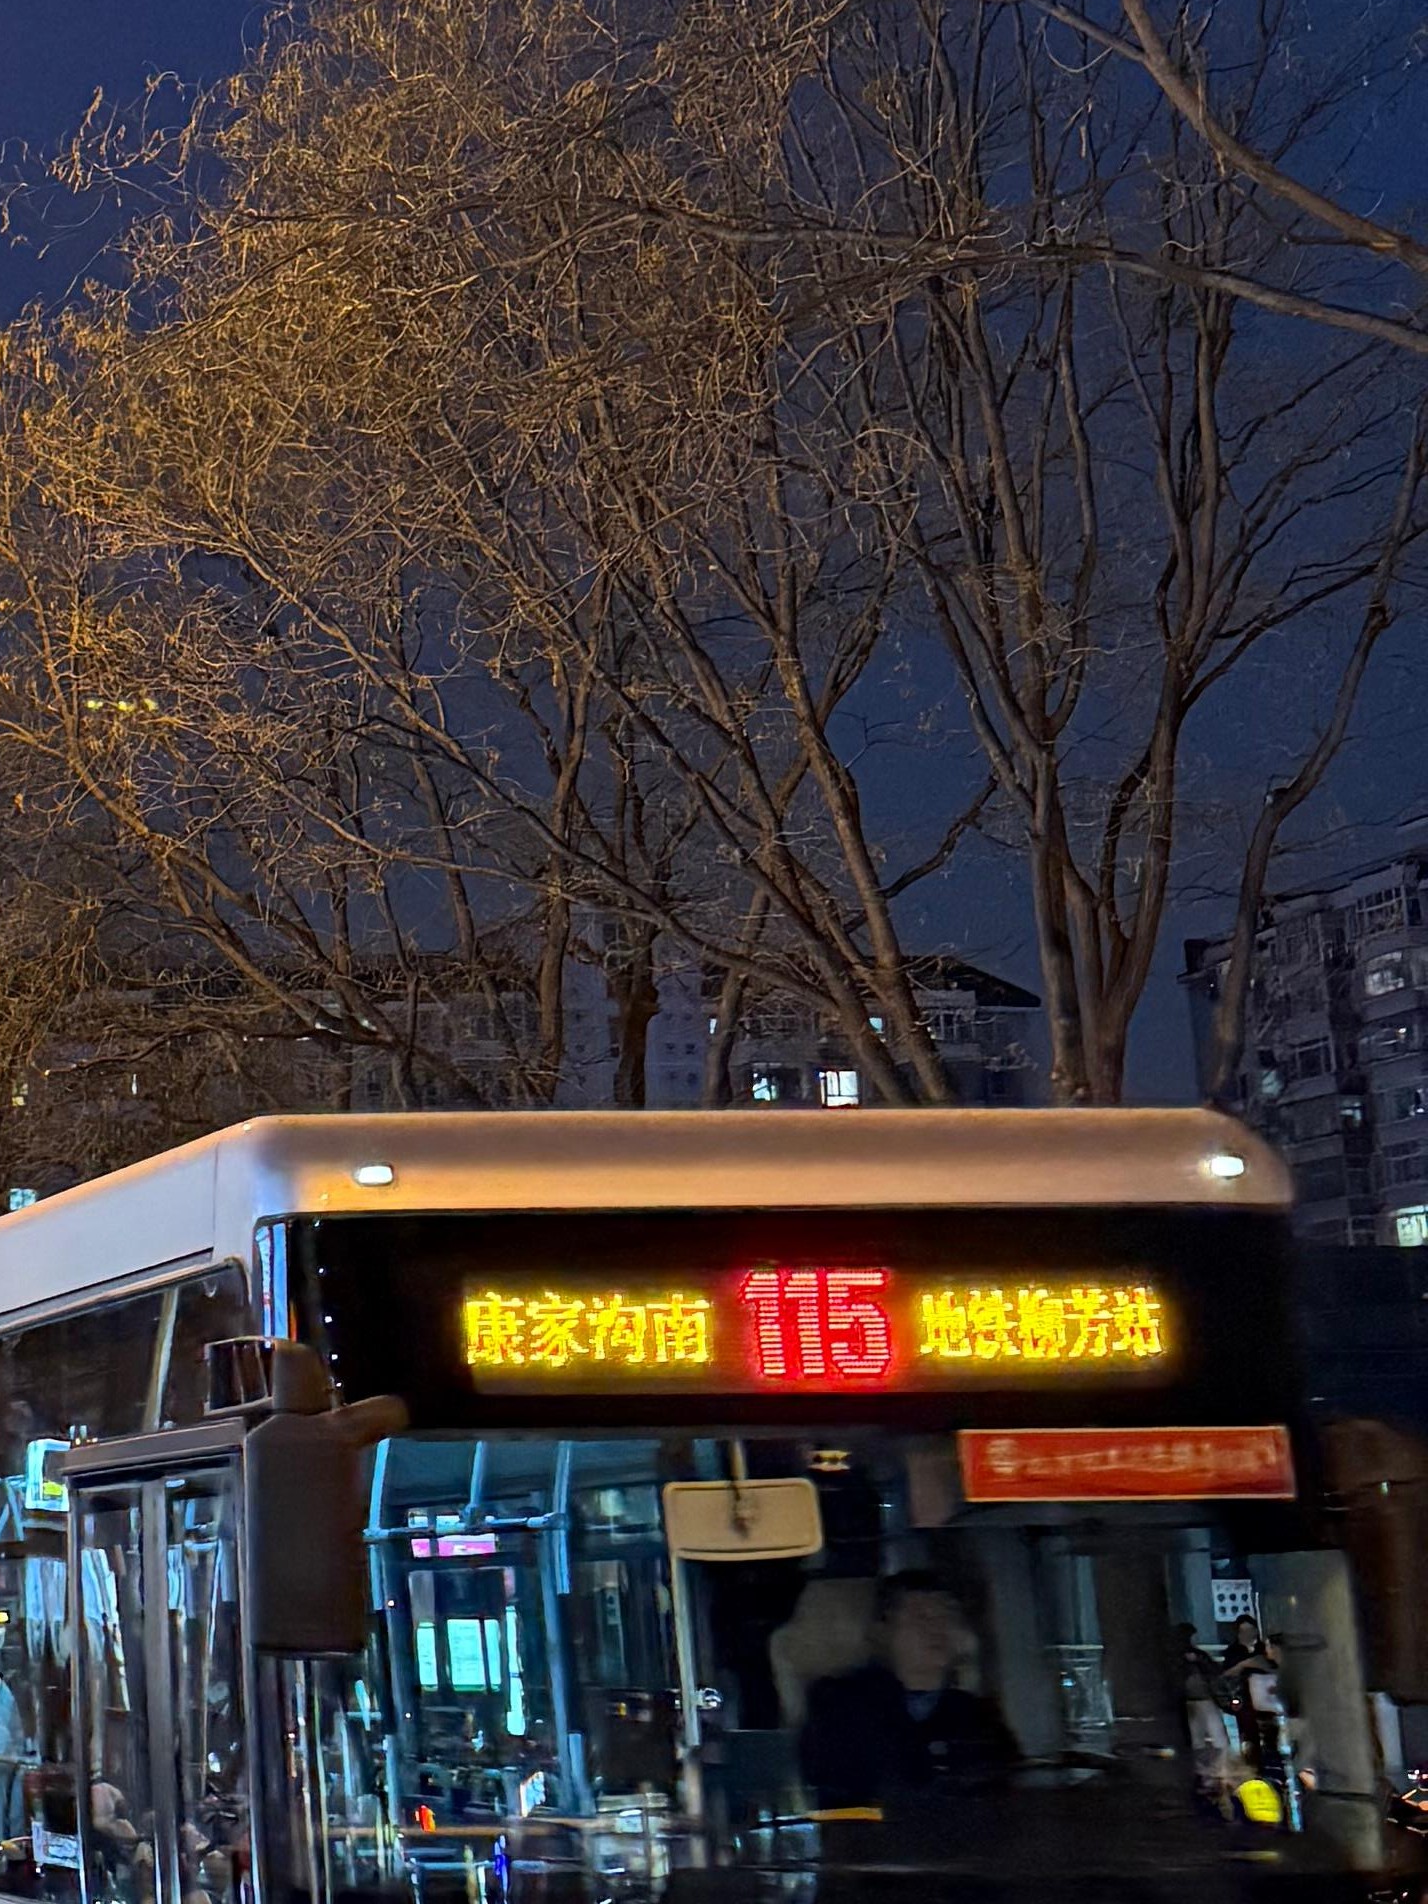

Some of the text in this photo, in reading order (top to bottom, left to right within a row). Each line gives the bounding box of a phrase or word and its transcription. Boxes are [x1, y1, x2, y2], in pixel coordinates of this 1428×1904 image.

[466, 1291, 711, 1367] 康家沟南
[743, 1270, 893, 1376] 115
